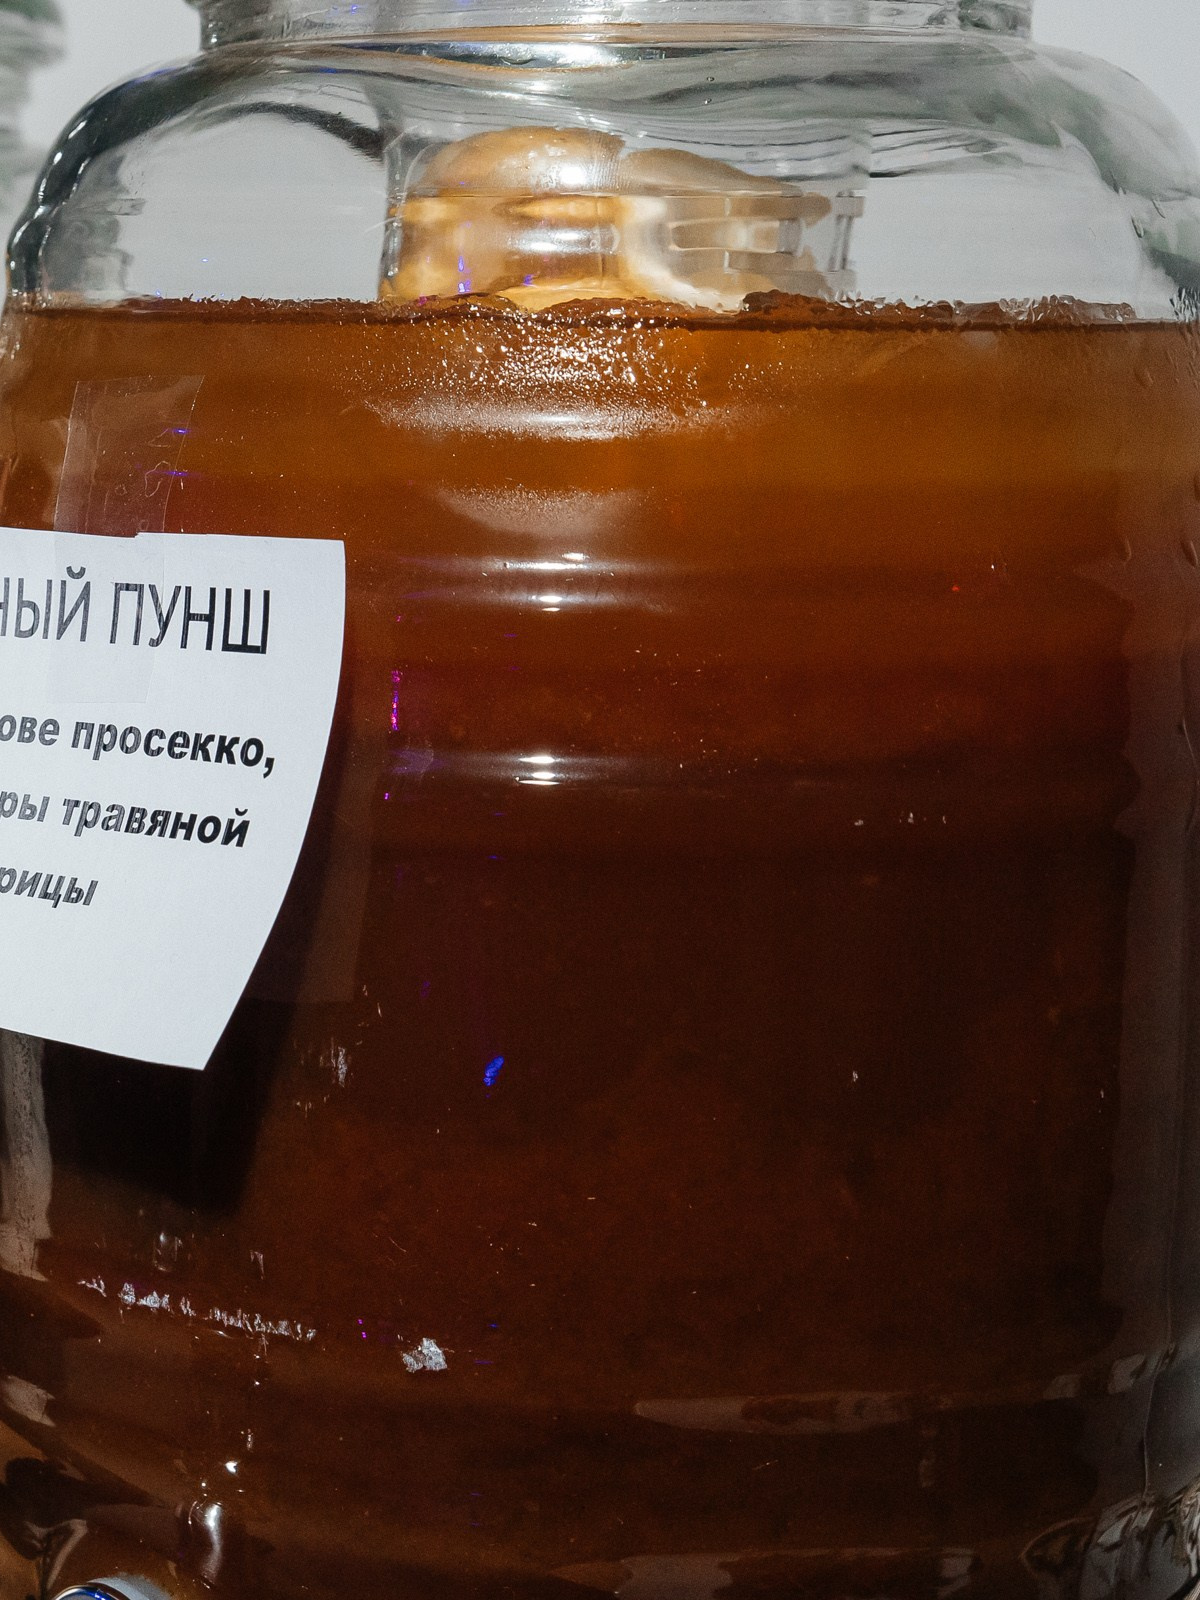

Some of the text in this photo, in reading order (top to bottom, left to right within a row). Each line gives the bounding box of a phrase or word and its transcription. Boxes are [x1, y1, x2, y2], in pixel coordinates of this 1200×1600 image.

[108, 581, 272, 656] ПУНШ
[70, 720, 276, 780] просекко,
[61, 797, 251, 849] травяной
